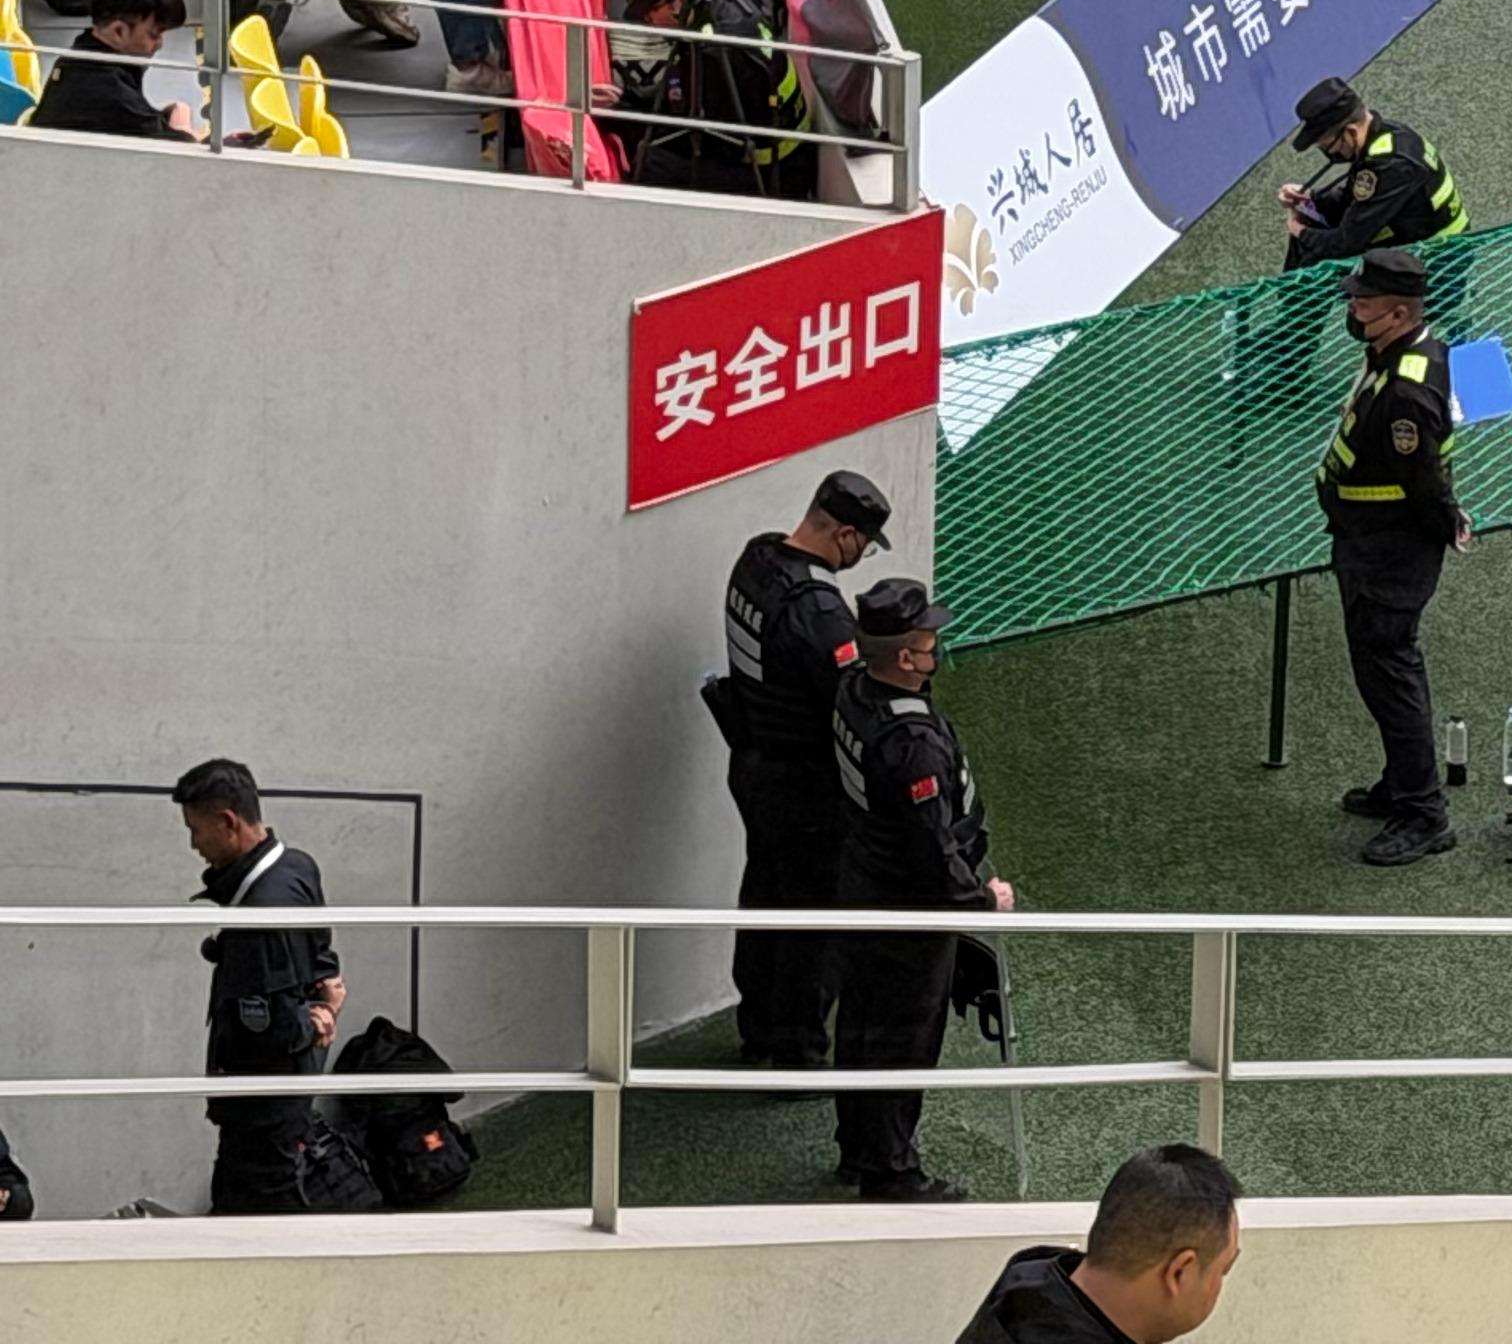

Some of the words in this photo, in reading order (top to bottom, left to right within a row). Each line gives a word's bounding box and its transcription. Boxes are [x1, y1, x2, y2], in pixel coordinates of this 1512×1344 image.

[986, 97, 1098, 236] 兴城人居
[654, 279, 921, 443] 安全出口
